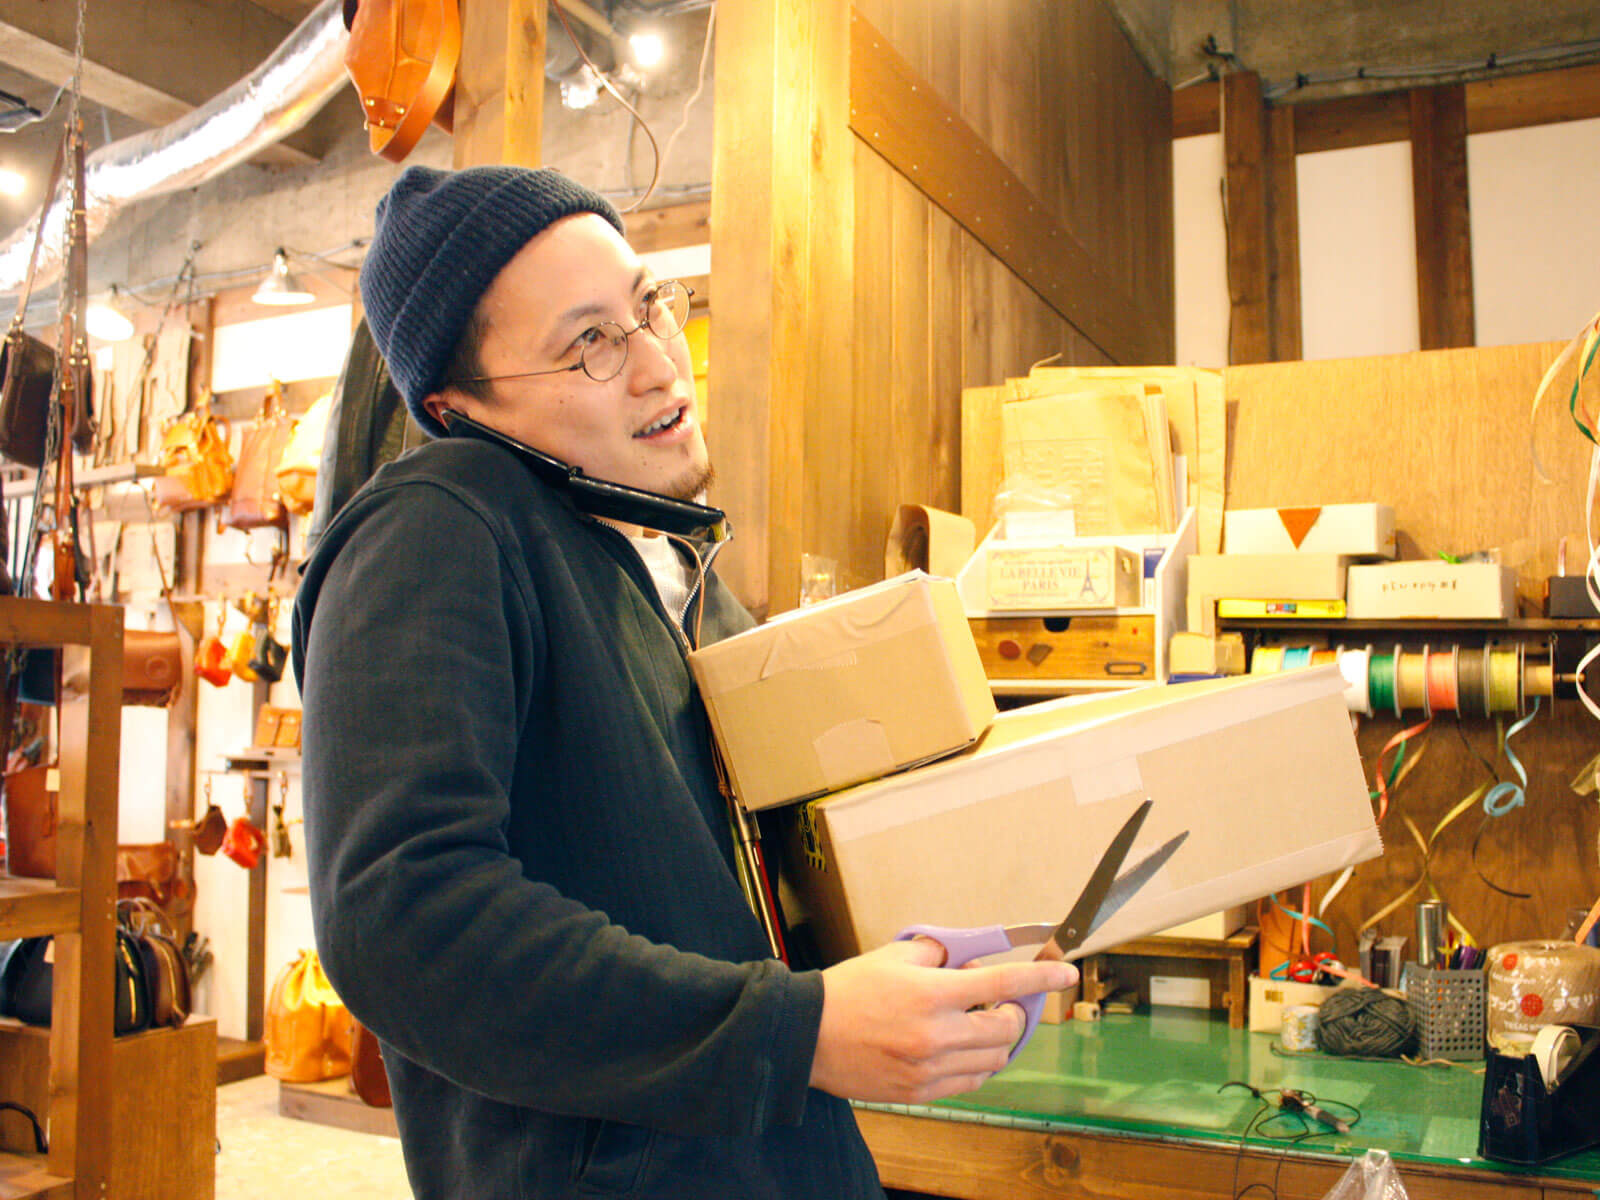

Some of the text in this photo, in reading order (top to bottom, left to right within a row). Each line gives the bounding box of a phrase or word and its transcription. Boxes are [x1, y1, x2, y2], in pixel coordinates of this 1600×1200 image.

[1018, 567, 1055, 578] BELLE
[1059, 566, 1079, 577] VIE
[1023, 580, 1059, 591] PARIS
